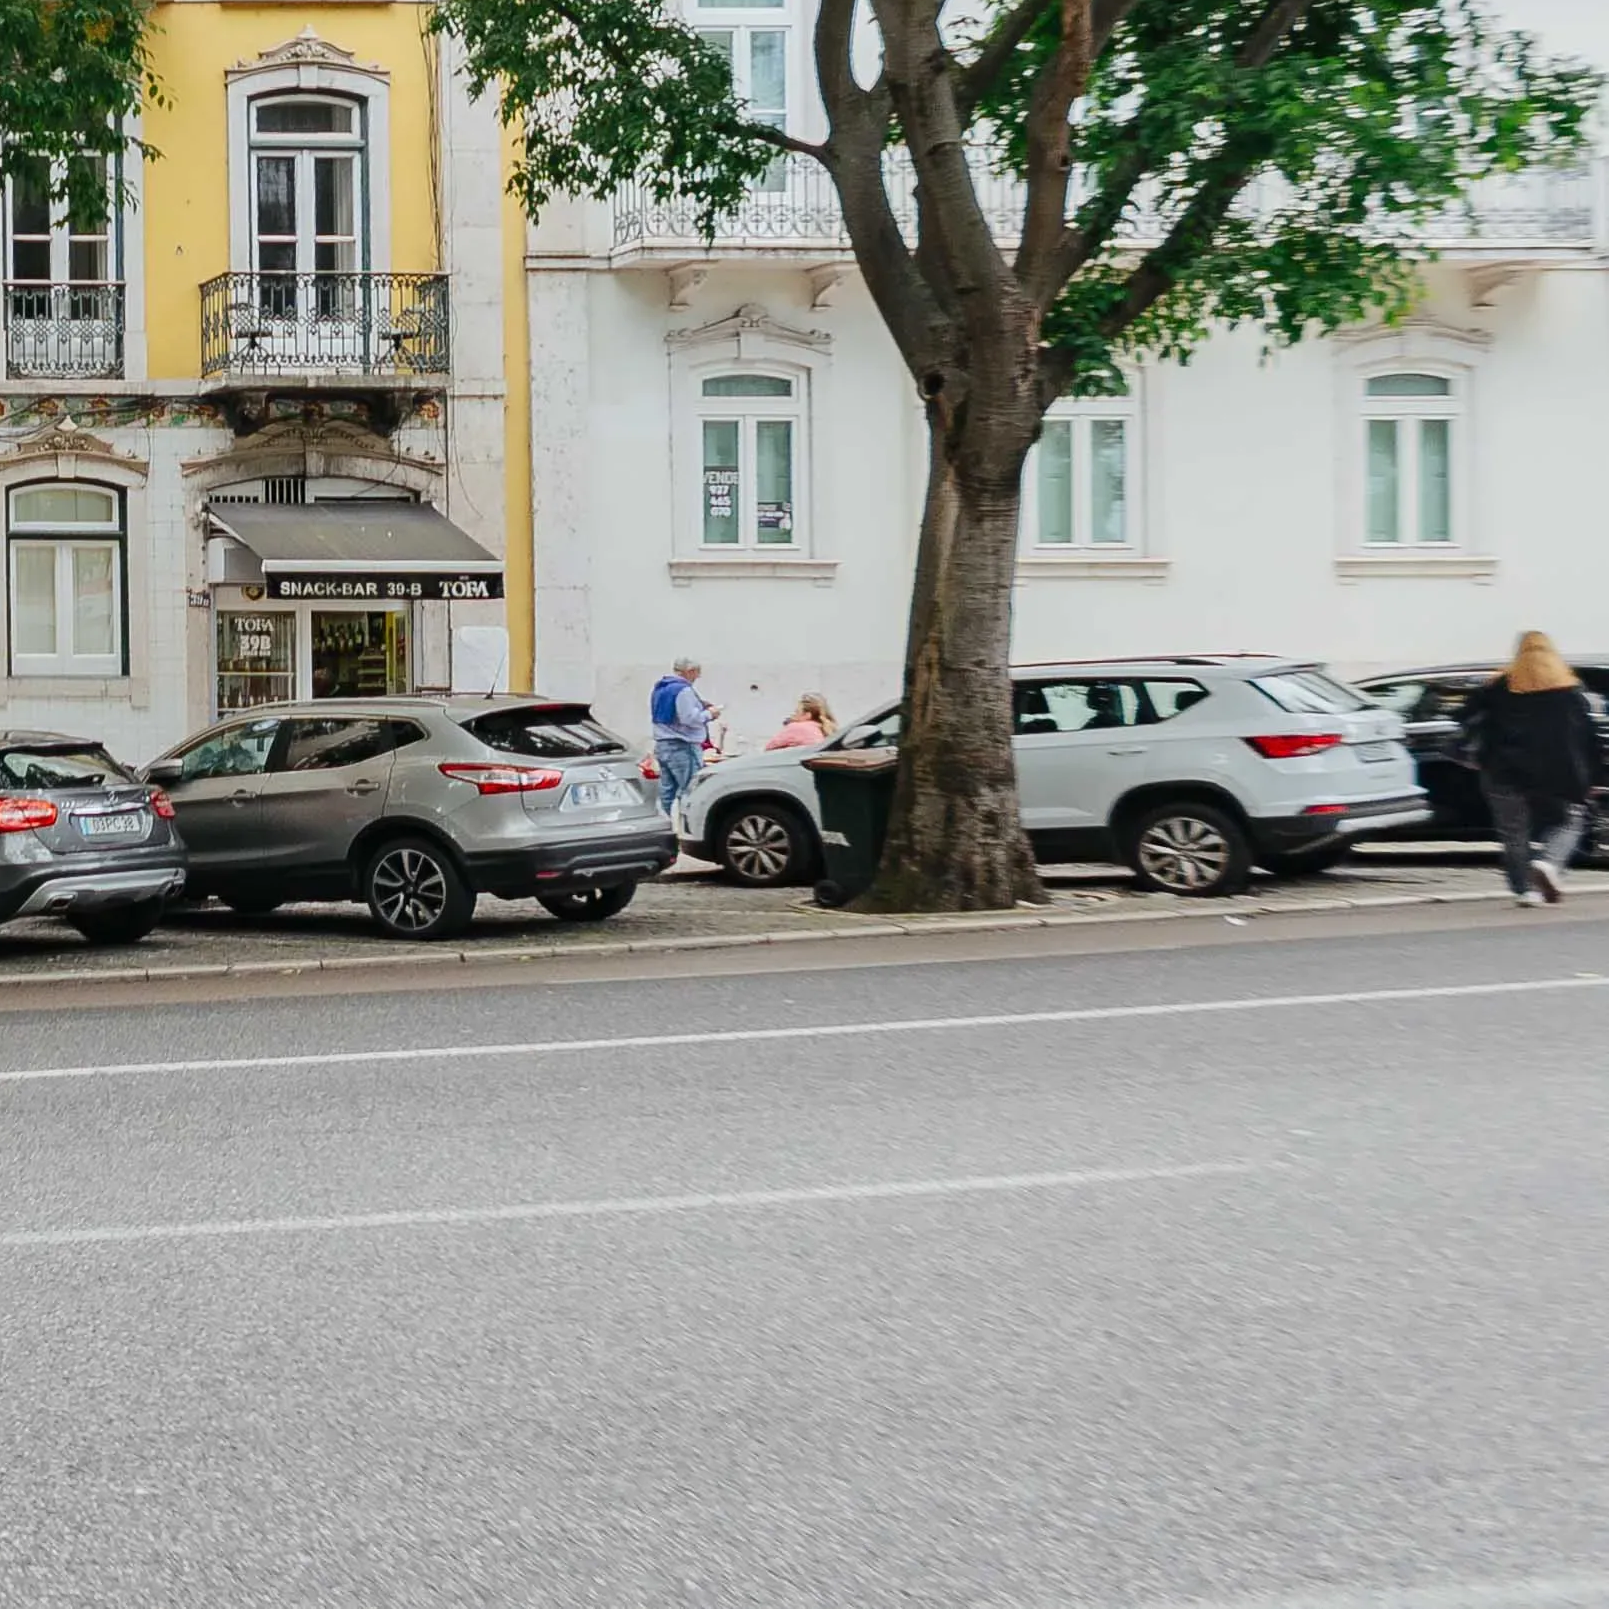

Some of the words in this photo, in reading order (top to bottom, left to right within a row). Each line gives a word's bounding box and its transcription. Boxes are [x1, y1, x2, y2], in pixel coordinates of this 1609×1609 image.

[279, 581, 378, 596] SNACK-BAR
[387, 582, 423, 596] 39-B
[240, 634, 272, 650] 39B
